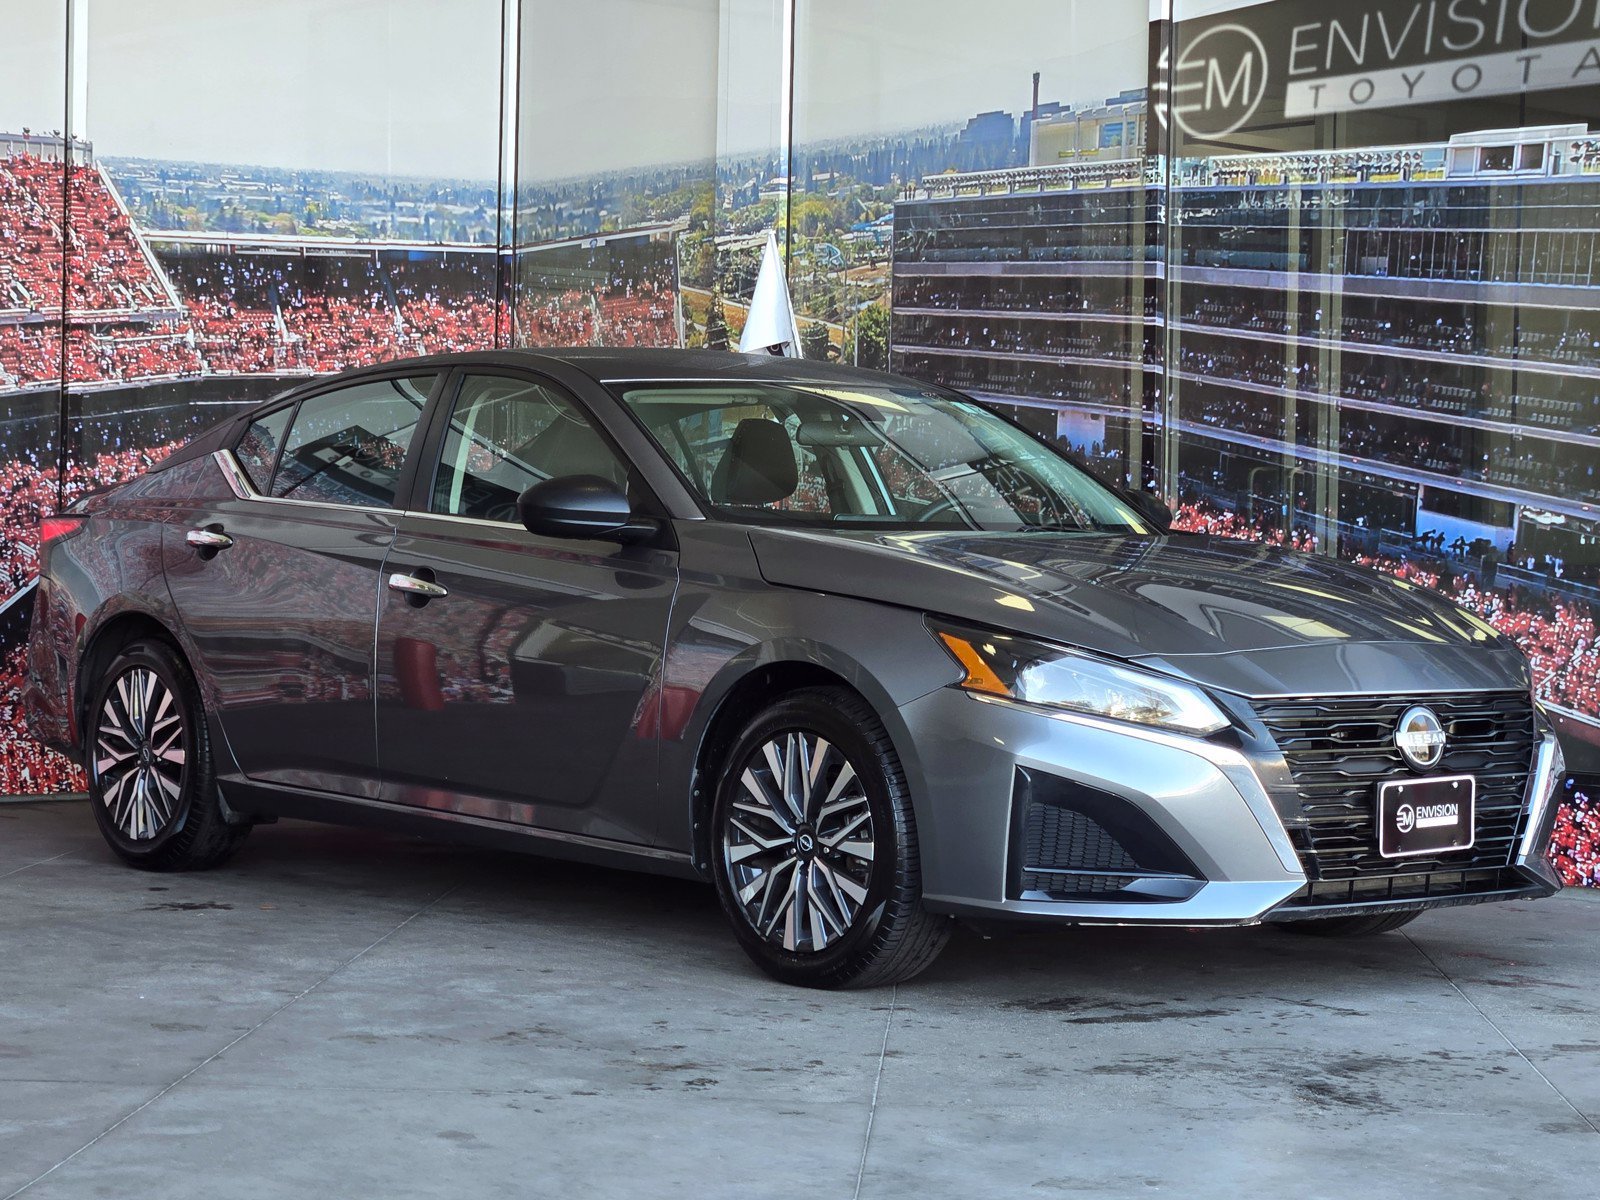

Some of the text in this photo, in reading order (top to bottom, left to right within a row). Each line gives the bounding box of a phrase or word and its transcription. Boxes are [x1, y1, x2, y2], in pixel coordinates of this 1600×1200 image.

[1288, 0, 1600, 76] ENVISIO
[1307, 46, 1600, 109] TOYOTA
[1398, 732, 1446, 745] ISSAN
[1416, 803, 1458, 818] ENVISION
